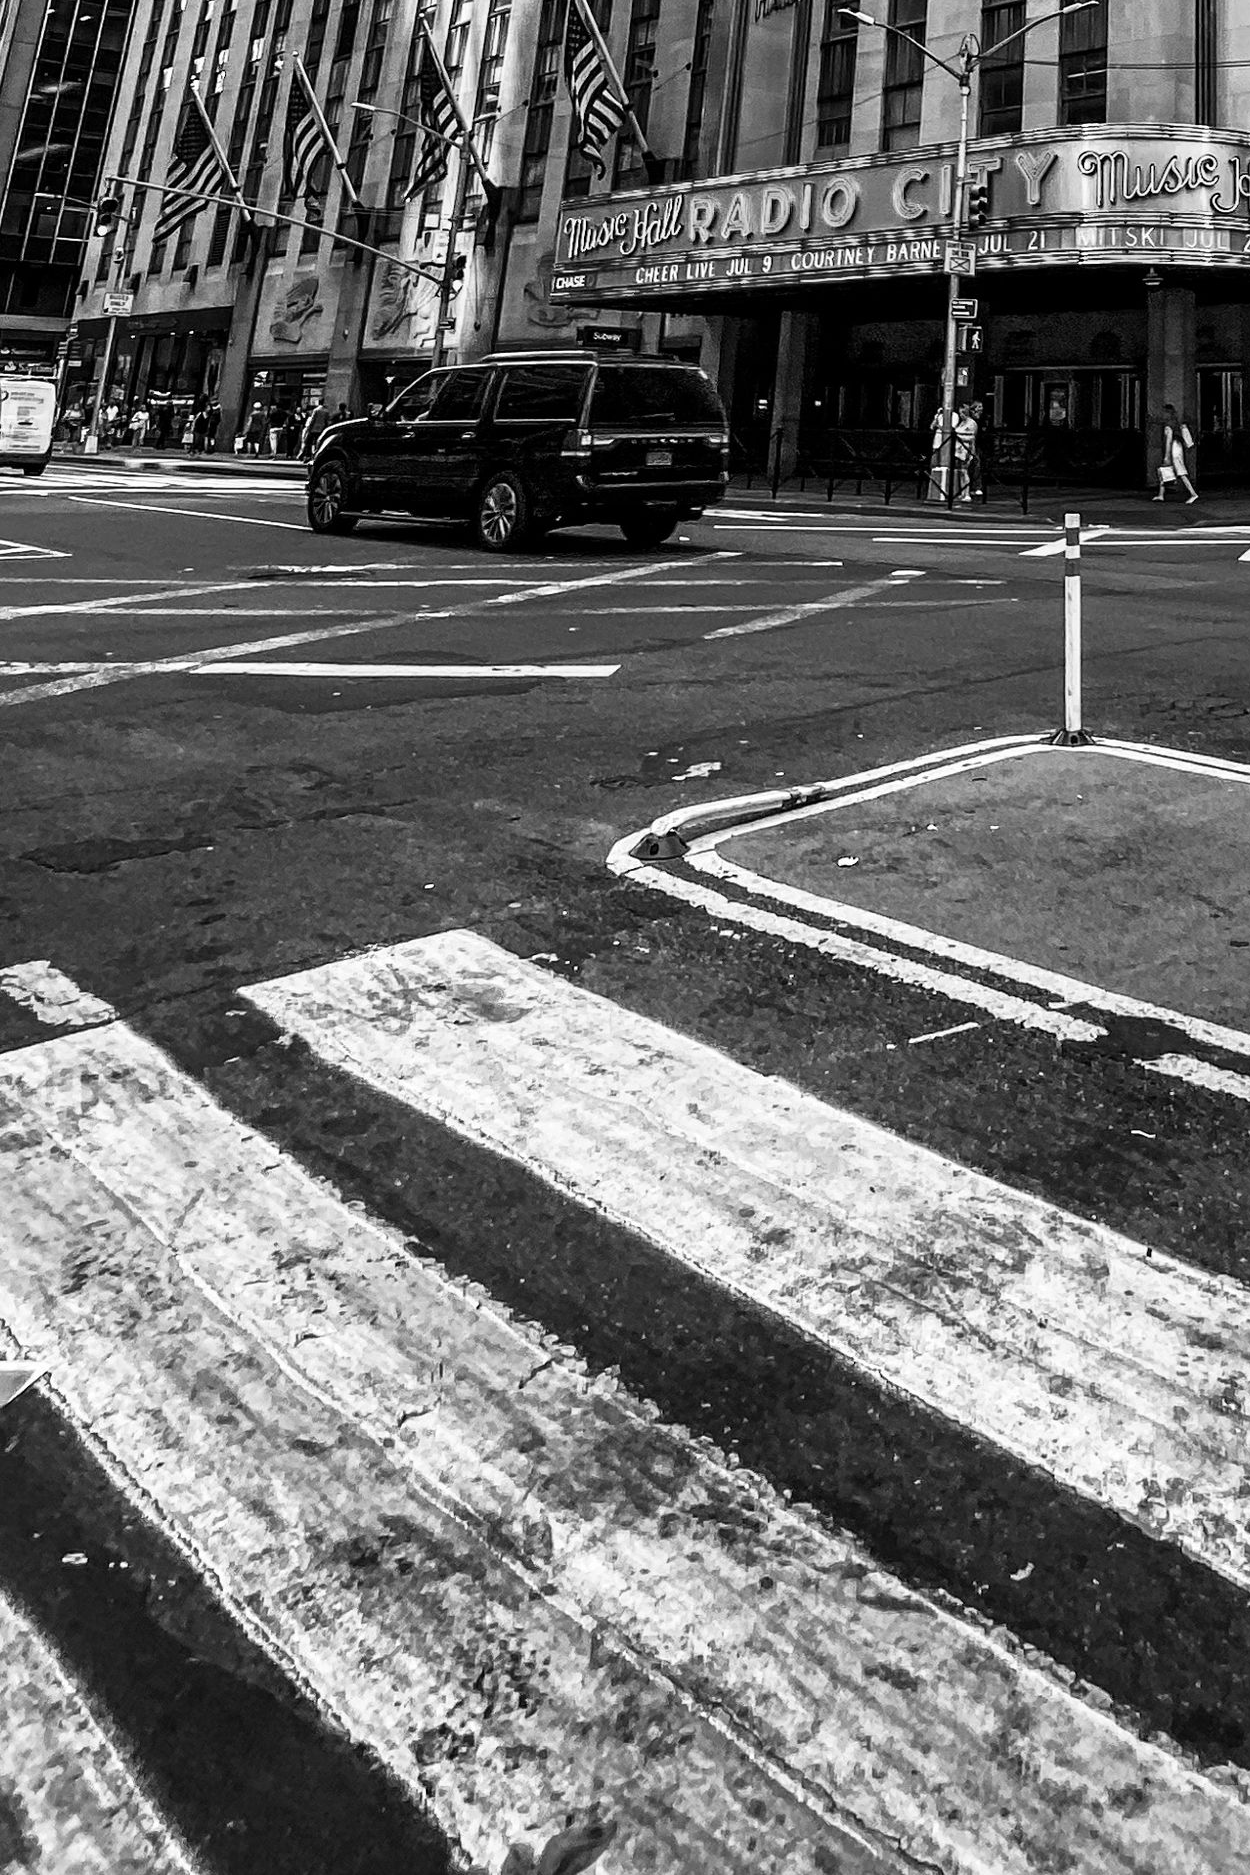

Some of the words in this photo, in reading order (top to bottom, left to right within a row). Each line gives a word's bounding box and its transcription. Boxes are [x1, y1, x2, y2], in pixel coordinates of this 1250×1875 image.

[563, 212, 627, 259] Music
[619, 194, 682, 255] Hall
[688, 178, 860, 243] RADIO
[893, 150, 1058, 221] CITY
[1077, 150, 1219, 205] Music
[556, 275, 585, 289] CHASE
[635, 264, 679, 284] CHEER
[686, 261, 715, 280] LIVE
[725, 257, 752, 276] JUL
[762, 255, 772, 274] 9
[790, 246, 875, 271] COURTNEY
[886, 239, 941, 262] BARNE
[978, 234, 1012, 255] JUL
[1027, 230, 1046, 251] 21
[1077, 226, 1164, 248] MITSKI
[1185, 228, 1229, 250] JUL
